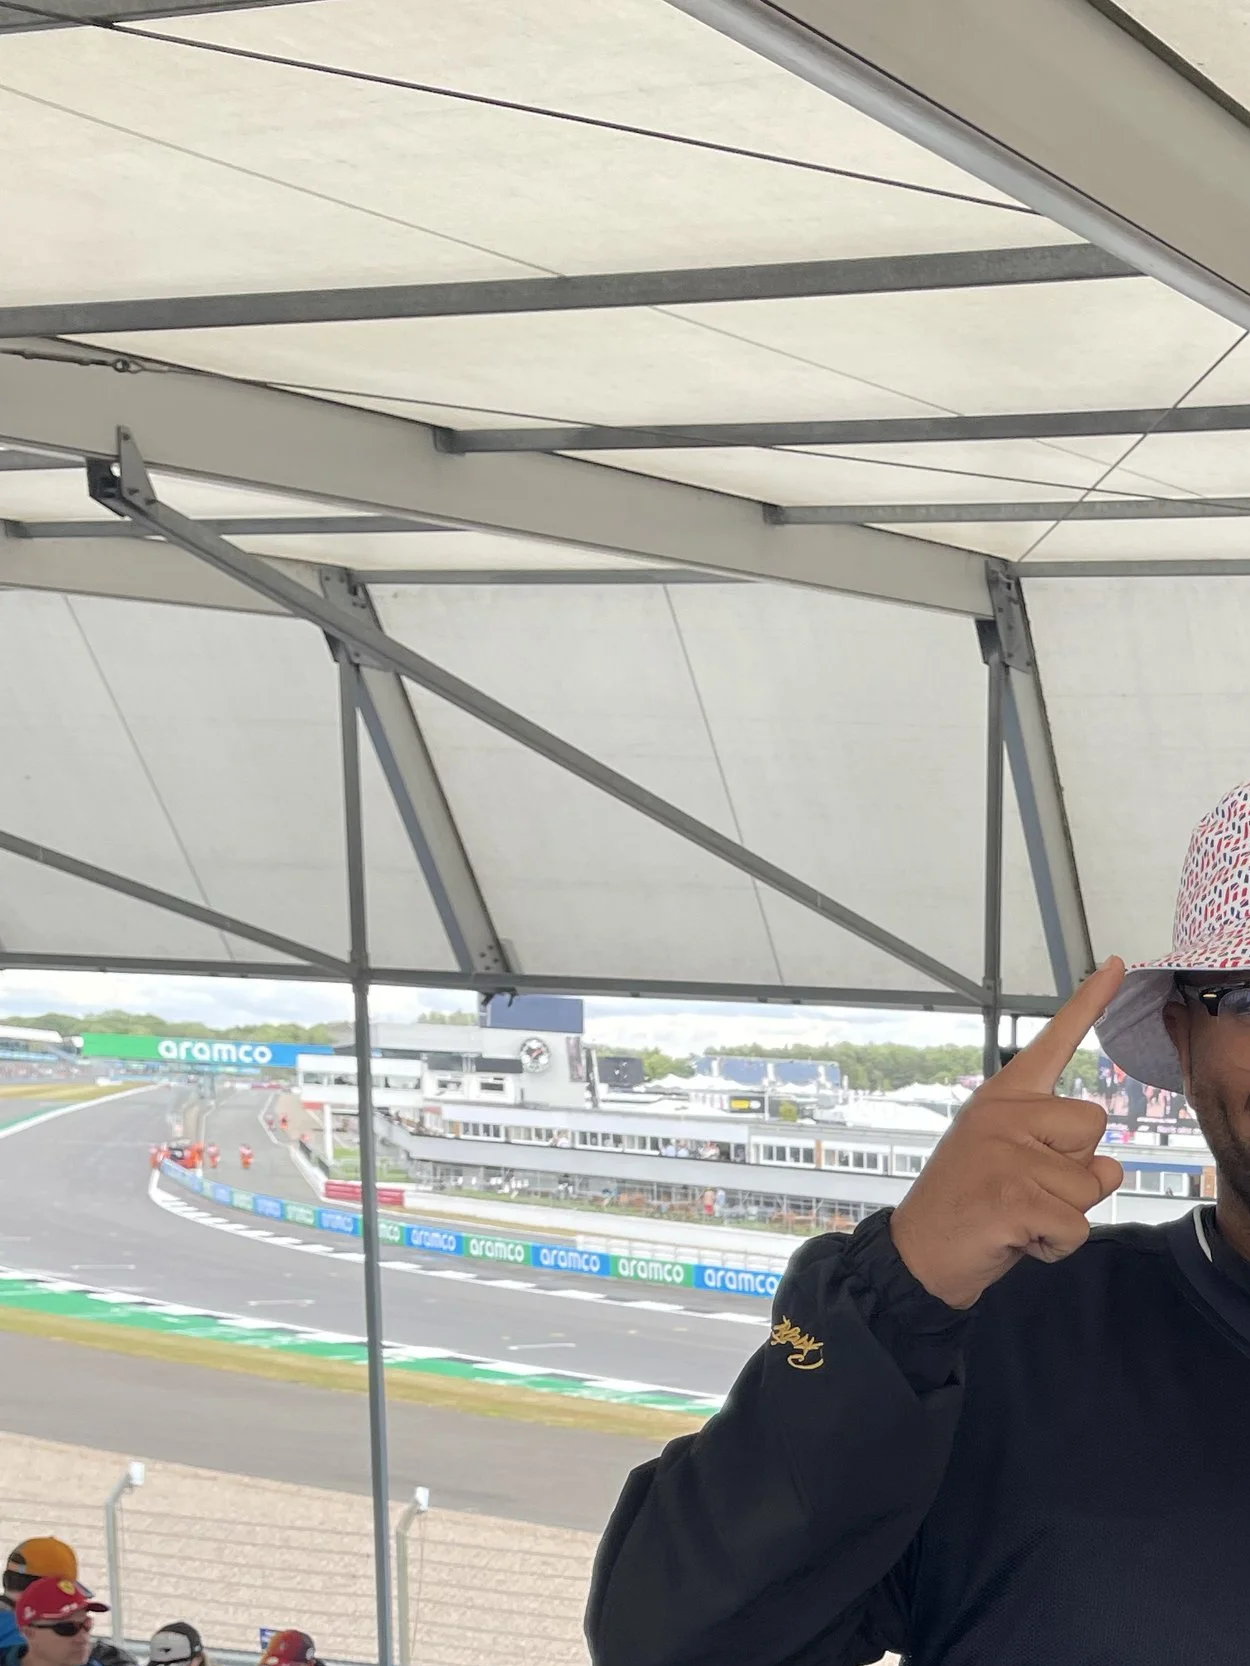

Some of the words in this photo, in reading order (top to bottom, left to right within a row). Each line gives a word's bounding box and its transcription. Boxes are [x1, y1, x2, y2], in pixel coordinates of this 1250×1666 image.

[158, 1040, 272, 1064] aramco
[411, 1228, 456, 1252] aramco
[469, 1235, 525, 1263] aramco
[540, 1245, 600, 1273] aramco
[618, 1254, 685, 1284] aramco
[704, 1264, 778, 1295] aramco
